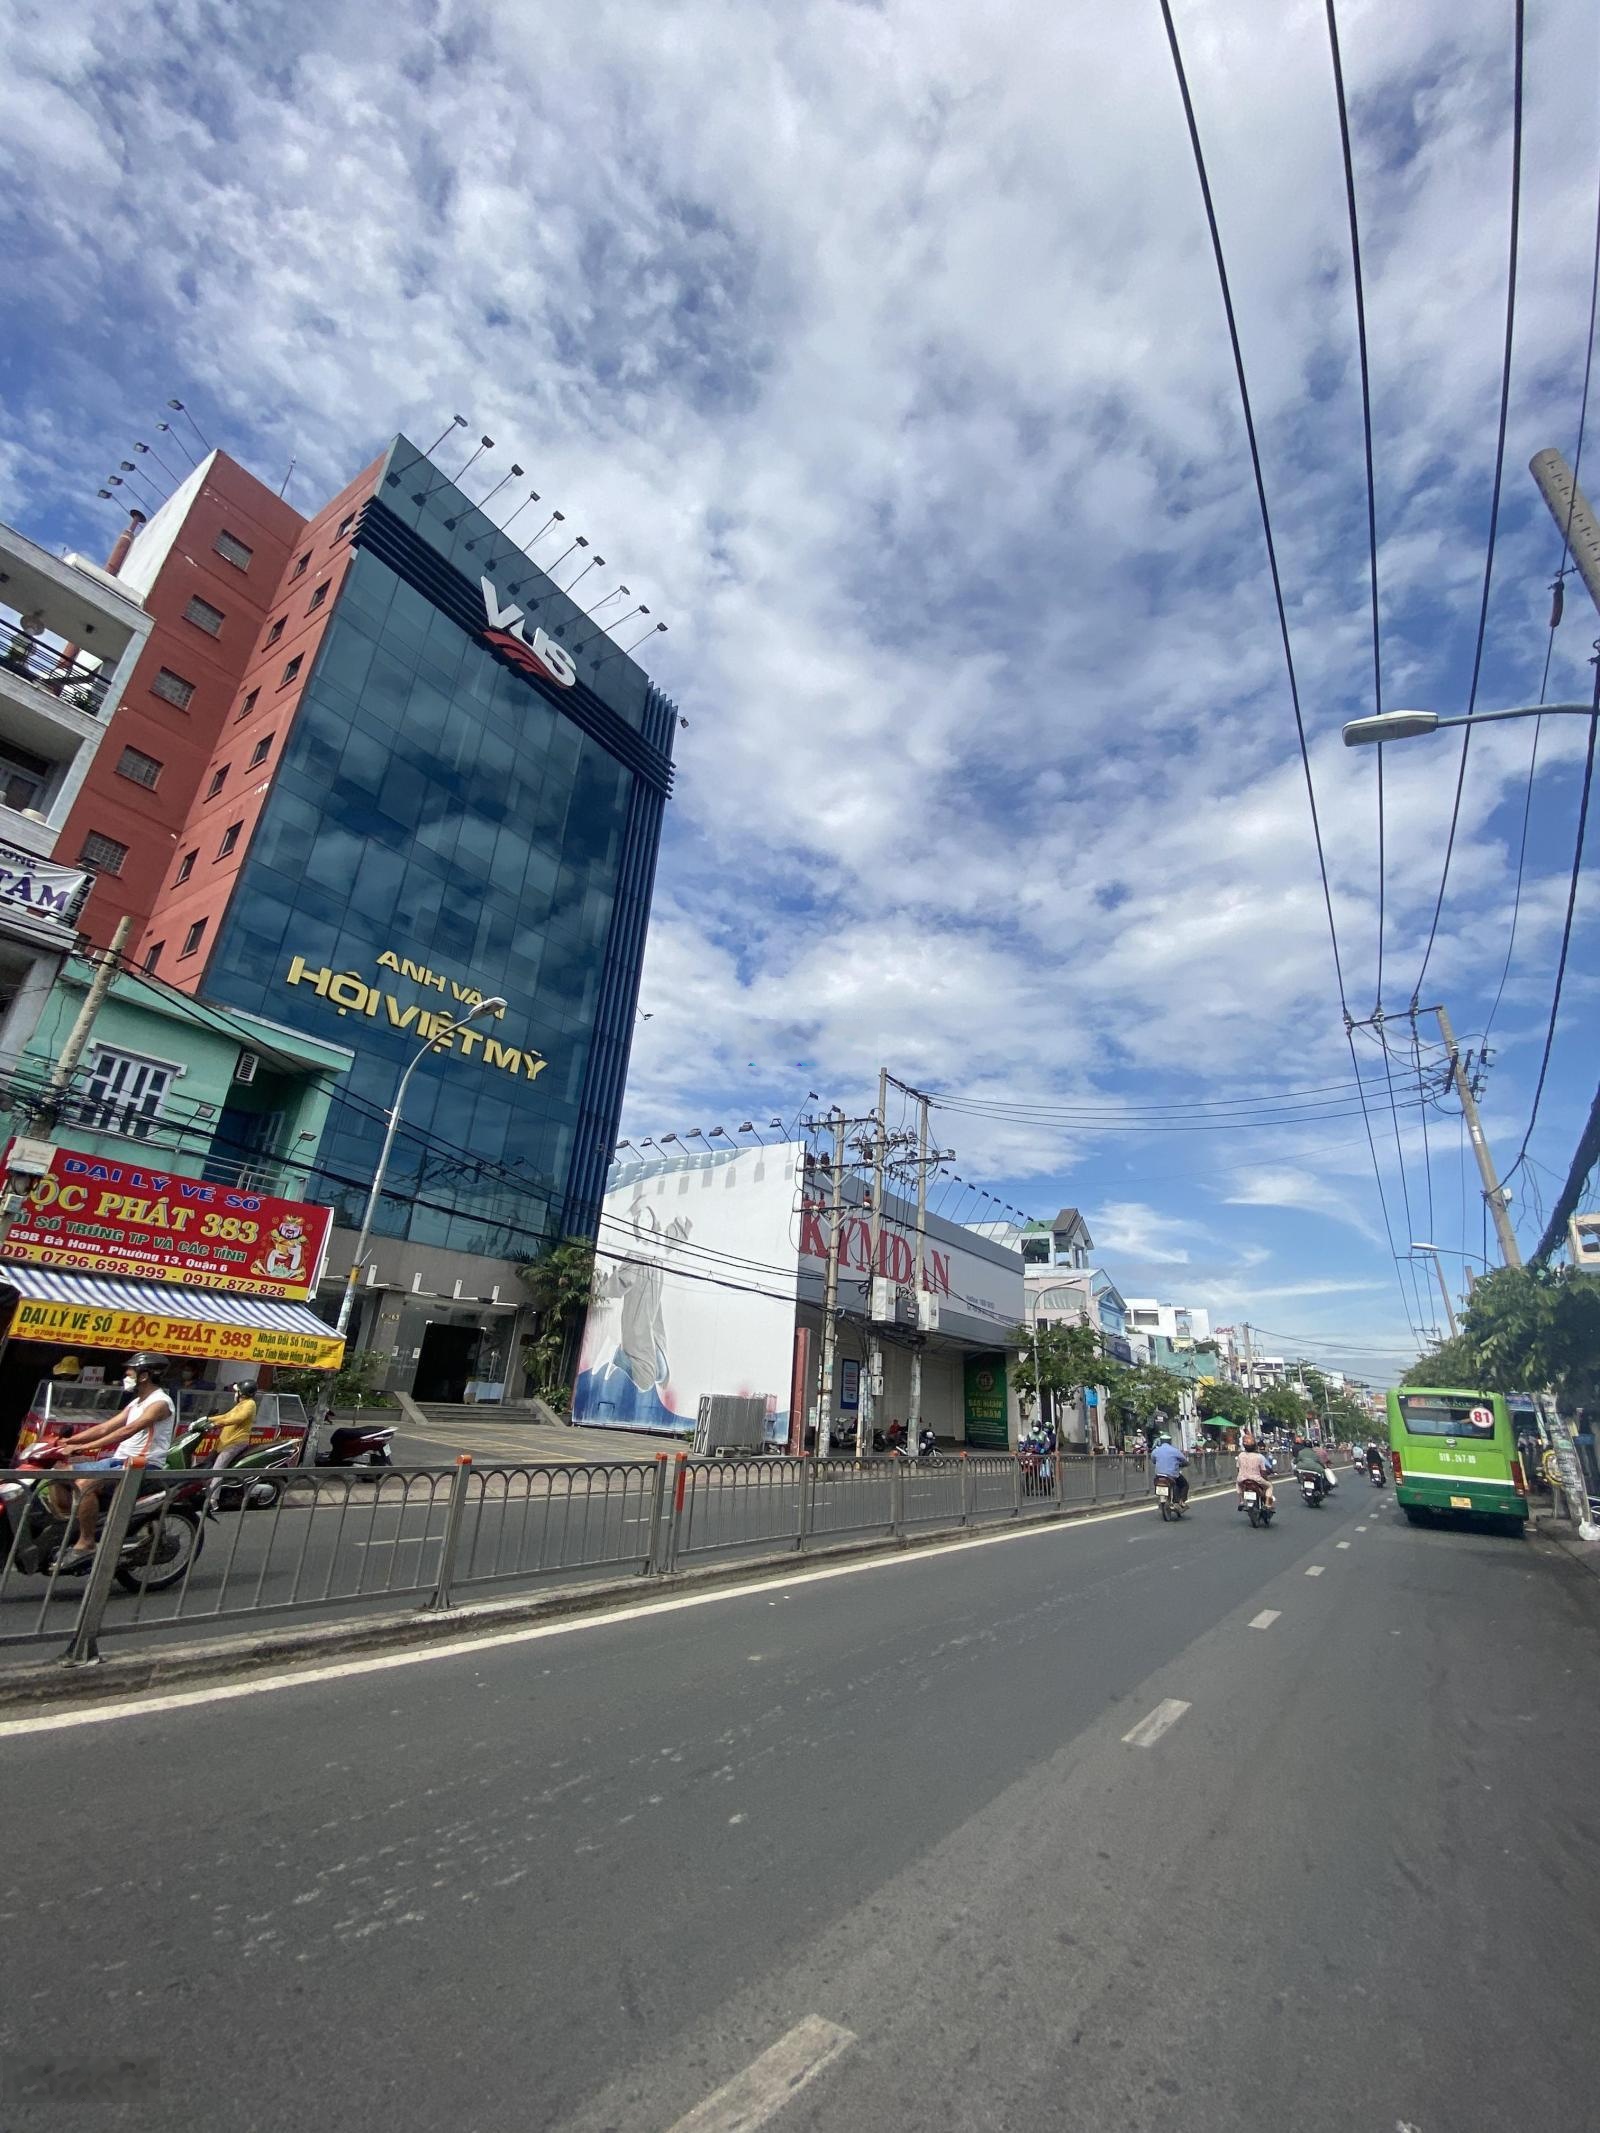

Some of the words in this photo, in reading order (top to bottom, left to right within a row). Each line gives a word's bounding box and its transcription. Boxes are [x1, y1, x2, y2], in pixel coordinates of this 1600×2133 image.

[376, 950, 447, 993] ANH
[451, 980, 506, 1020] VĂ
[286, 955, 381, 1017] HỘI
[385, 994, 484, 1055] VIỆT
[482, 1038, 549, 1081] MỸ
[30, 1173, 88, 1211] ỘC
[94, 1192, 195, 1231] PHÁT
[200, 1213, 259, 1244] 383
[64, 1159, 122, 1182] ĐẠI
[131, 1173, 171, 1191] LÝ
[181, 1183, 216, 1202] VÉ
[224, 1194, 266, 1211] SỐ
[9, 1229, 40, 1242] 59B
[44, 1234, 63, 1246] Bà
[34, 1215, 65, 1230] SỐ
[66, 1221, 125, 1241] TRÚNG
[129, 1232, 150, 1245] TP
[153, 1236, 174, 1250] VÀ
[178, 1240, 210, 1256] CÁC
[213, 1246, 247, 1263] TỈNH
[41, 1250, 166, 1279] 0796.698.999
[183, 1272, 286, 1296] 0917.872.828
[20, 1306, 48, 1328] ĐẠI
[49, 1307, 70, 1327] LÝ
[71, 1310, 90, 1330] VÉ
[92, 1311, 116, 1332] SỐ
[118, 1315, 160, 1339] LỘC
[163, 1323, 216, 1343] PHÁT
[220, 1330, 252, 1348] 383
[1473, 1411, 1490, 1424] 81
